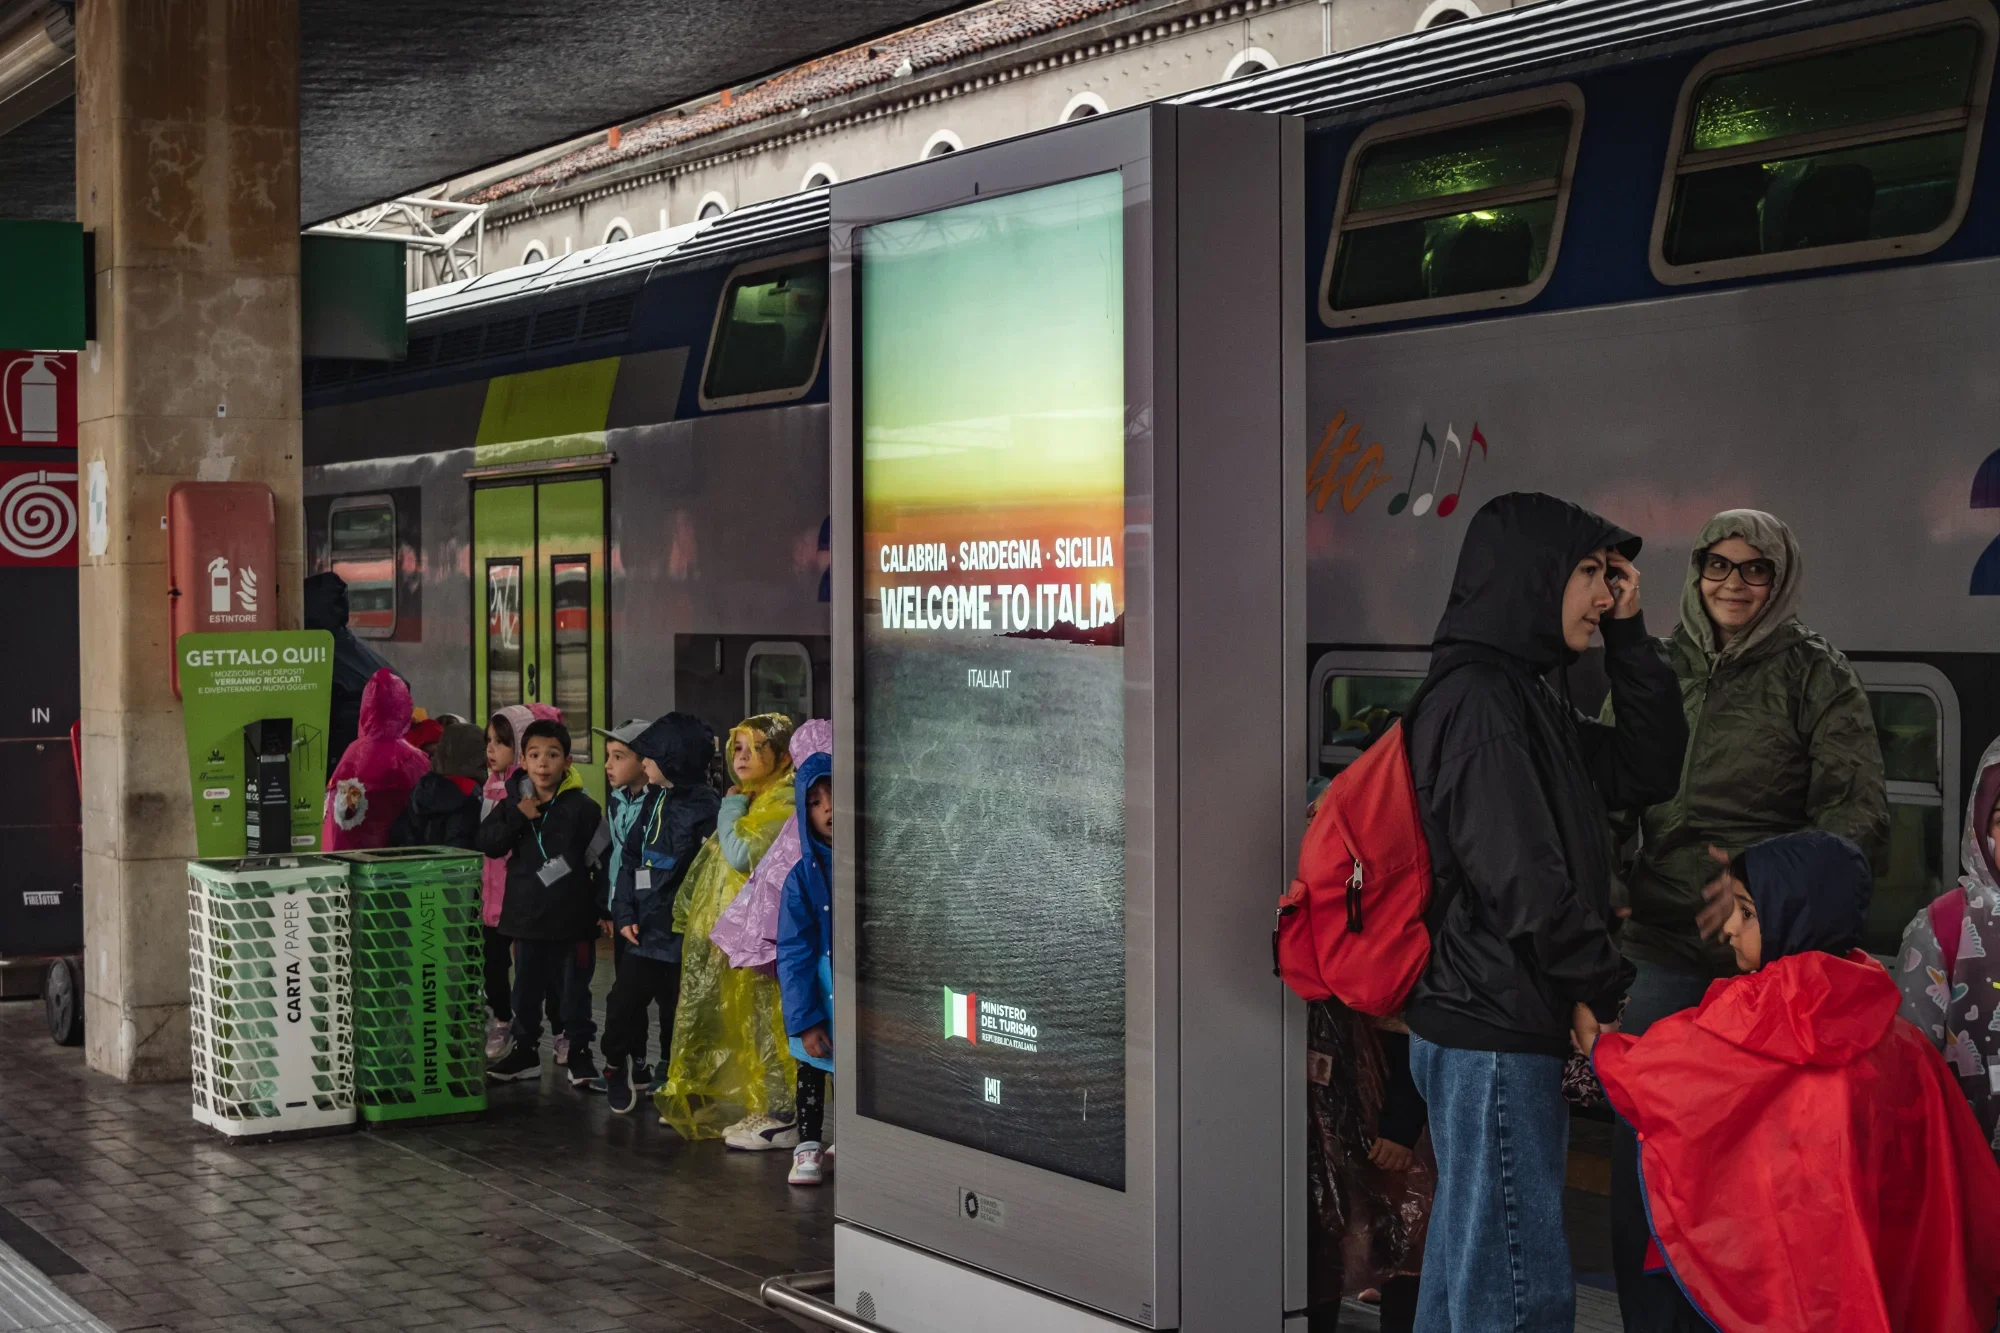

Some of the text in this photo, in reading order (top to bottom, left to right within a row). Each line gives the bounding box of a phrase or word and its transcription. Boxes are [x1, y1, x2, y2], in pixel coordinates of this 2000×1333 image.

[880, 536, 1114, 572] CALABRIA SARDEGNA SICILIA
[880, 582, 1116, 631] WELCOME TO ITALIA
[209, 614, 257, 624] ESTINTORE
[186, 647, 326, 667] GETTALO QUI!
[215, 669, 256, 677] MOZZICONI
[273, 668, 305, 676] DEPOSITI
[215, 676, 301, 686] VERRANNO RICICLATI
[968, 668, 1012, 689] ITALIA.IT
[204, 685, 261, 695] DIVENTERANNO
[263, 684, 286, 692] NUOVI
[286, 683, 318, 691] OGGETTI
[31, 707, 50, 724] IN
[981, 1000, 1027, 1021] MINISTERO
[981, 1014, 1038, 1038] DEL TURISMO
[423, 1020, 439, 1086] RIFIUTI
[982, 1033, 1038, 1053] REPUBBLICA ITALIANA
